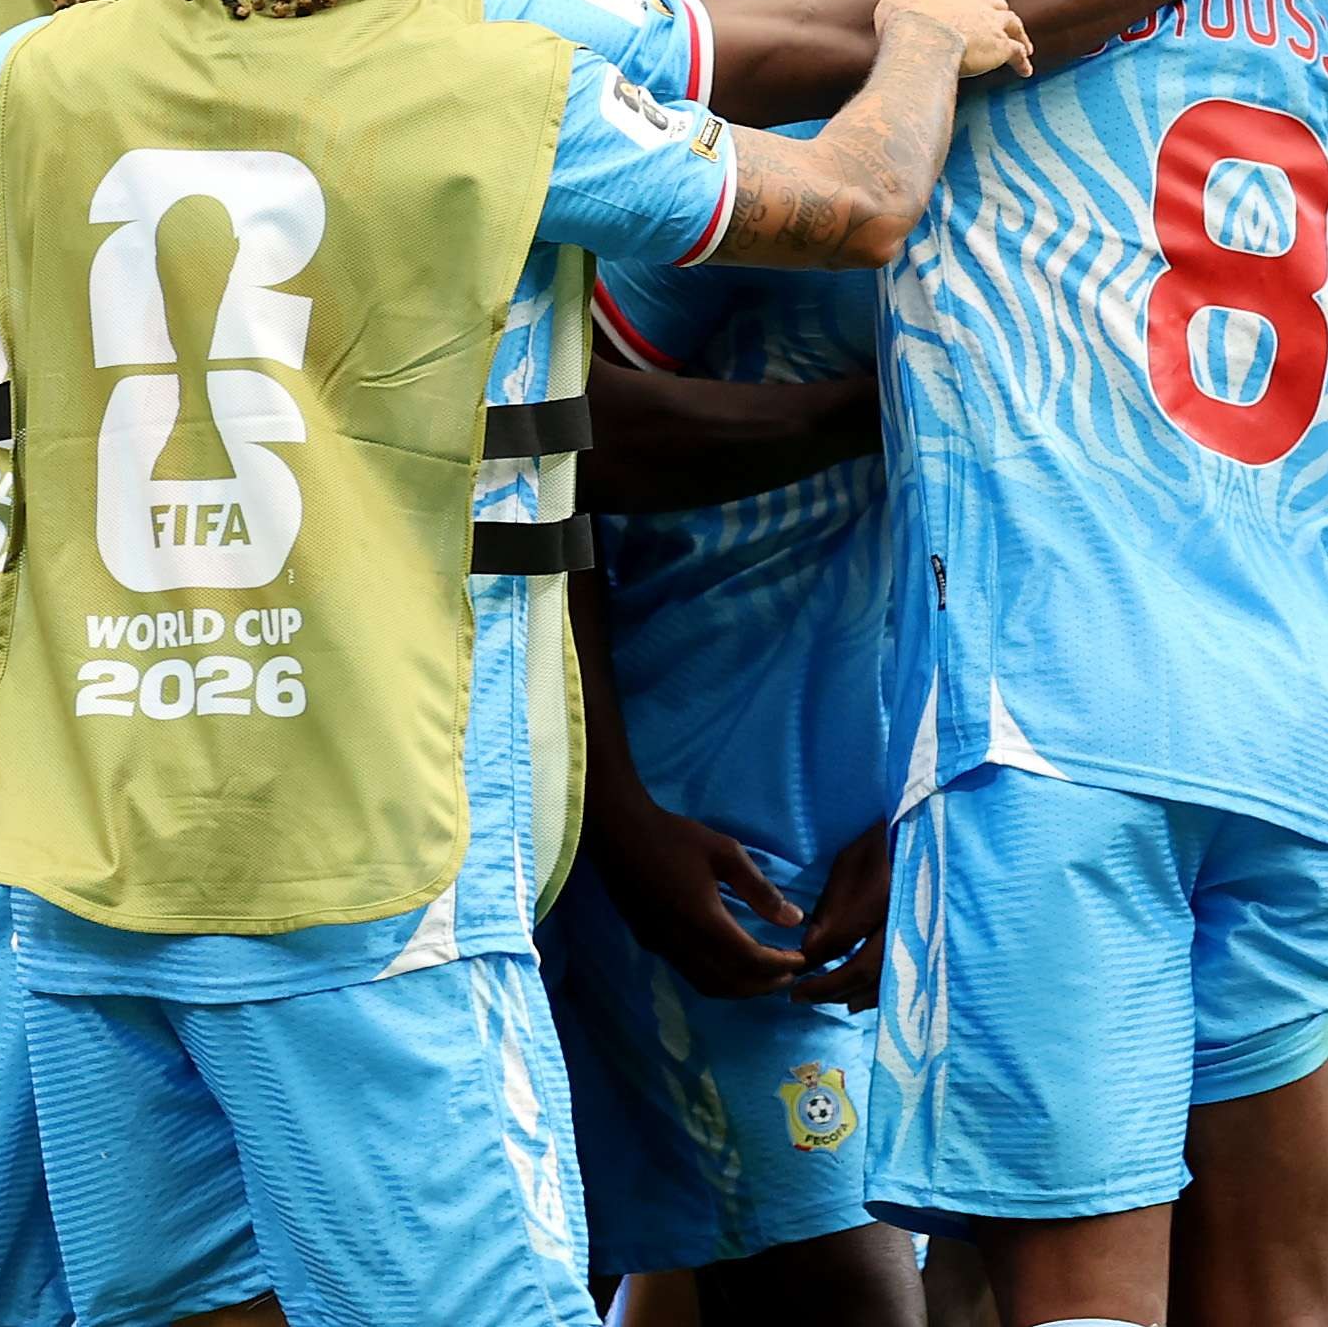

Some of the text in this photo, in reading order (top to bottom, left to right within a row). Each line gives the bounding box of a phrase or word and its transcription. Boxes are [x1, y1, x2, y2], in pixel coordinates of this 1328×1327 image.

[150, 503, 252, 548] FIFA
[86, 608, 303, 651] WORLD CUP
[75, 655, 307, 720] 2026
